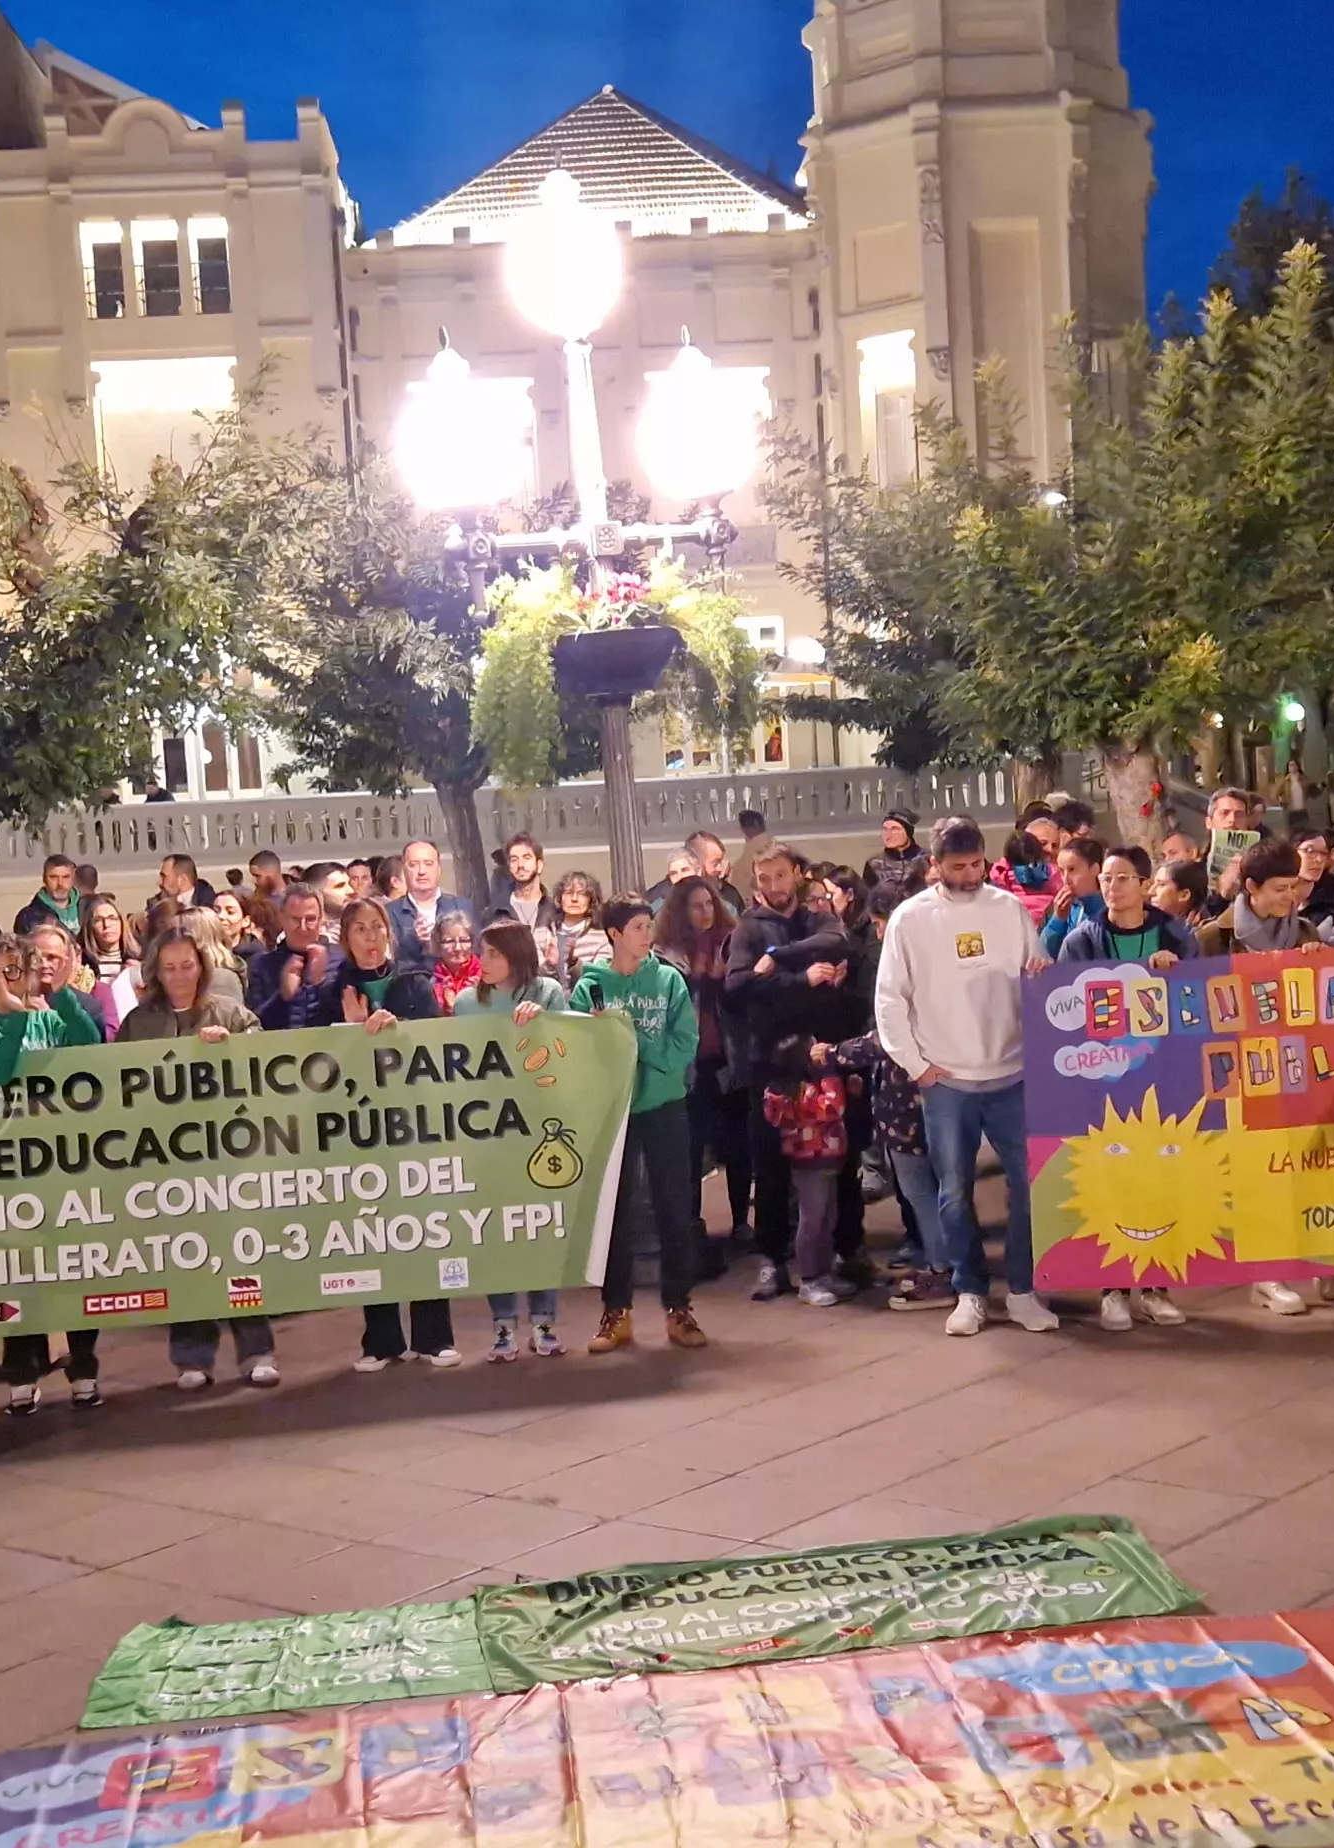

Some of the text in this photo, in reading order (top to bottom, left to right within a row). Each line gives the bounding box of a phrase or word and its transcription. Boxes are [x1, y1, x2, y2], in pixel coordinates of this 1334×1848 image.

[1227, 831, 1248, 850] NO!
[1049, 994, 1085, 1018] VIVA
[120, 1049, 358, 1108] PÚBLICO,
[373, 1040, 516, 1088] PARA
[316, 1094, 533, 1152] PÚBLICA
[1268, 1151, 1296, 1174] LA
[55, 1187, 116, 1228] AL
[124, 1162, 389, 1220] CONCIERTO
[398, 1156, 477, 1198] DEL
[233, 1222, 312, 1265] 0-3
[319, 1205, 453, 1258] AÑOS
[458, 1207, 493, 1246] Y
[502, 1200, 567, 1243] FP!
[323, 1279, 345, 1290] UGT
[85, 1295, 142, 1312] CCOO
[942, 1533, 1065, 1557] PARA
[620, 1569, 893, 1613] EDUCACIÓN
[679, 1607, 731, 1626] AL
